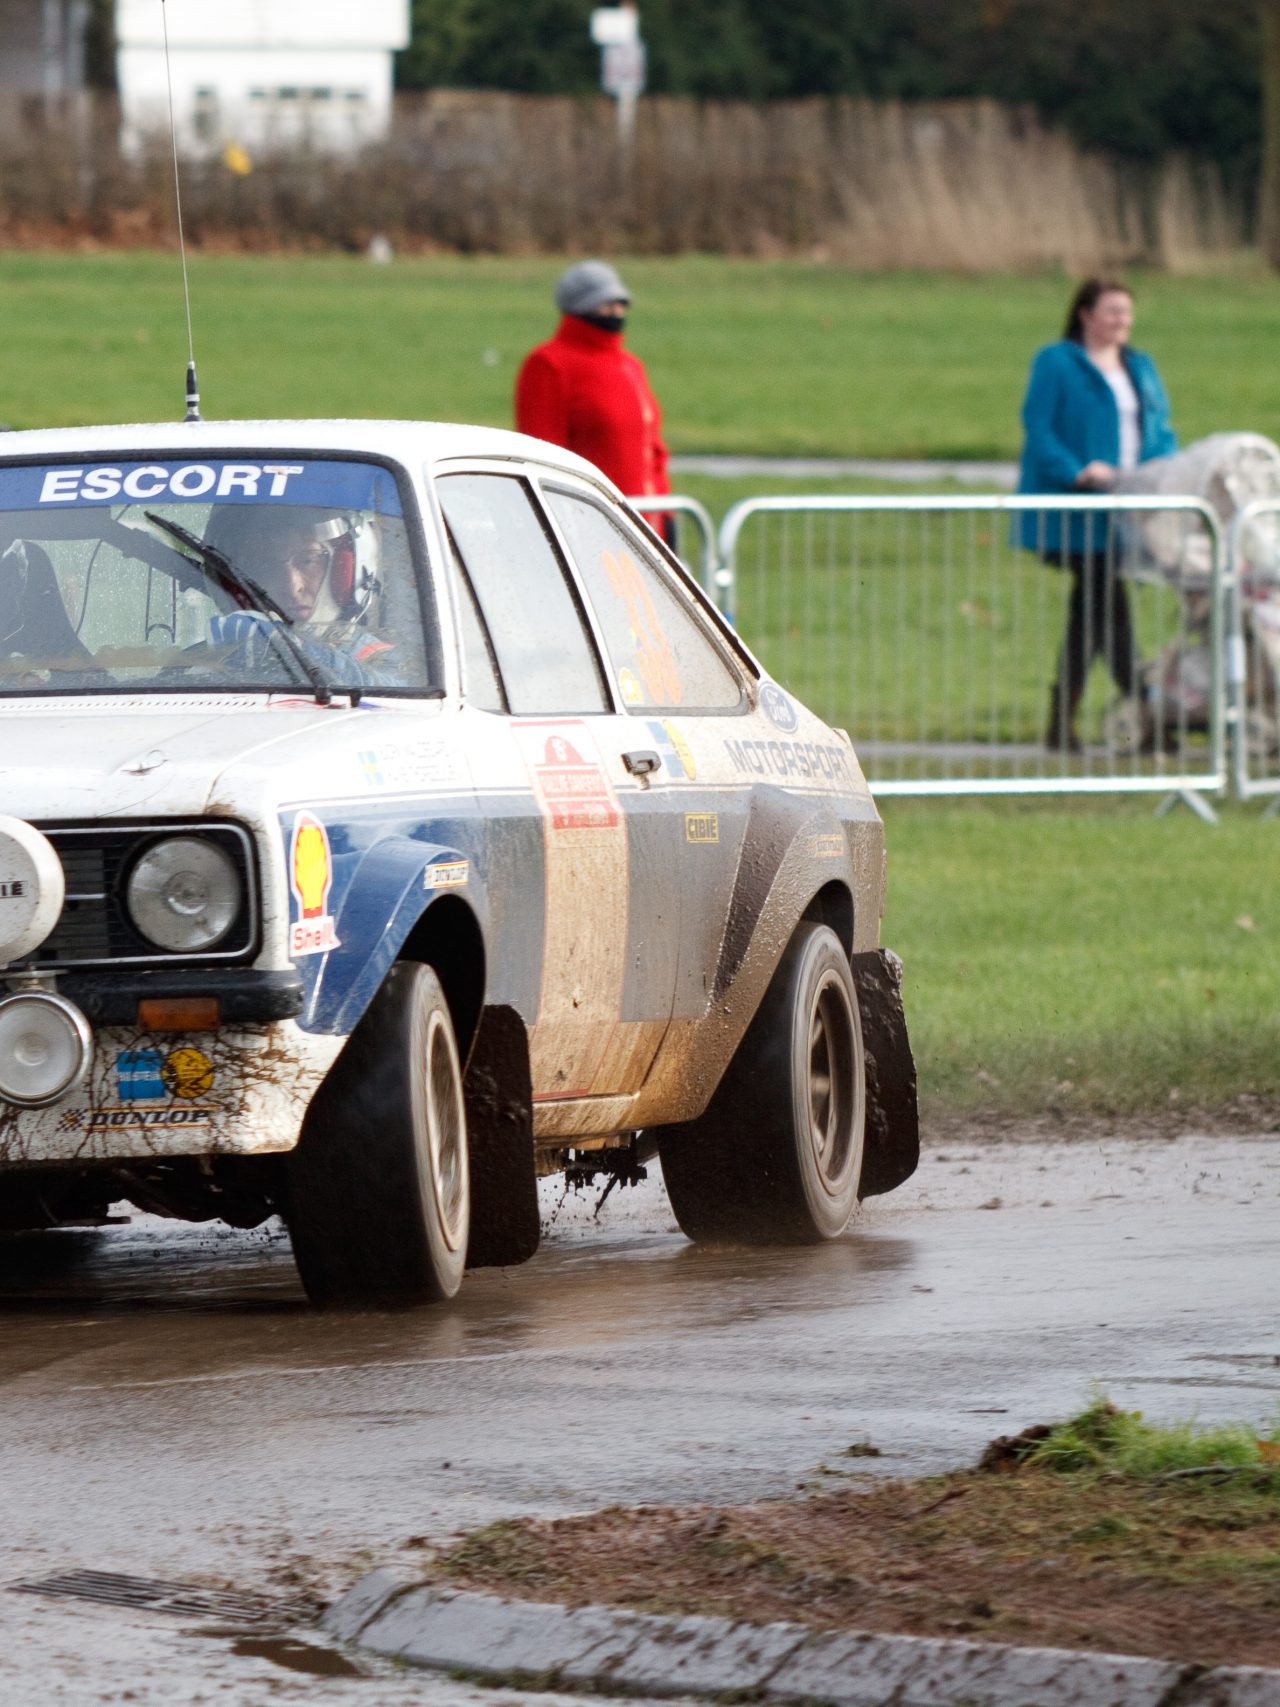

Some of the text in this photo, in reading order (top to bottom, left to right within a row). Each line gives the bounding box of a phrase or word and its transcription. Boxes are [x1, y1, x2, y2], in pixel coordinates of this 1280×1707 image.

[40, 465, 302, 503] ESCORT
[766, 689, 793, 722] Ford
[723, 740, 852, 787] MOTORSPORT
[294, 922, 334, 950] Shell
[86, 1109, 211, 1128] DUNLOP
